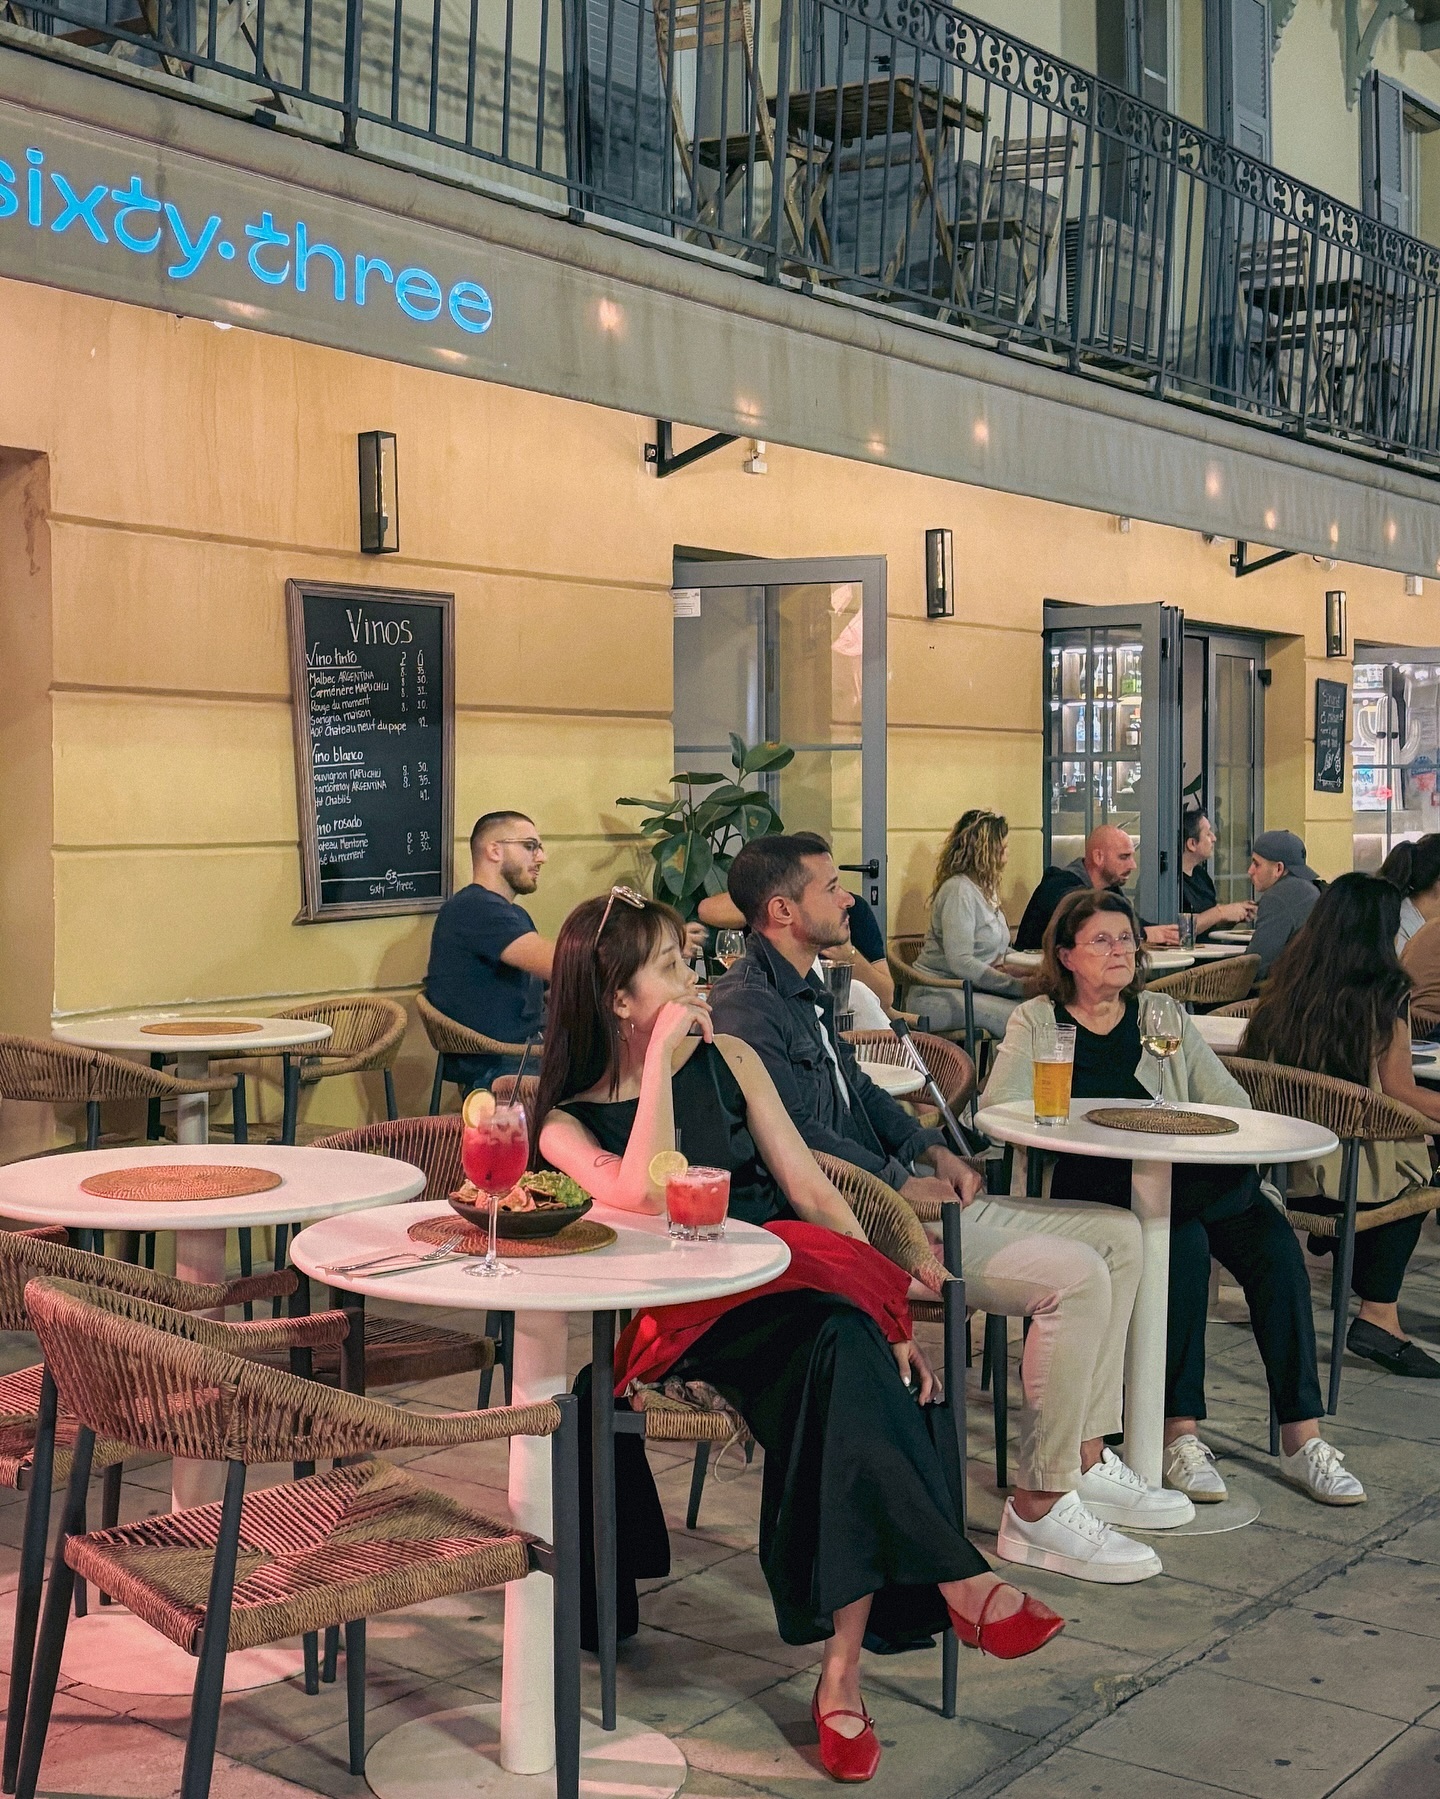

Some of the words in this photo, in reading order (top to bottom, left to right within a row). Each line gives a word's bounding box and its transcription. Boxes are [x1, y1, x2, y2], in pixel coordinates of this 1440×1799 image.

[346, 608, 413, 645] Vinos
[306, 642, 333, 666] Vino
[335, 648, 357, 664] tinto
[310, 672, 336, 686] Malbec
[310, 700, 330, 715] Rouge
[332, 699, 341, 710] du
[341, 693, 371, 709] moment
[310, 716, 341, 727] Sangria
[343, 709, 372, 722] maison
[333, 746, 364, 762] blanco
[314, 771, 348, 784] auvignon
[325, 794, 352, 807] Chablis
[333, 814, 363, 831] rosado
[385, 868, 398, 885] 63
